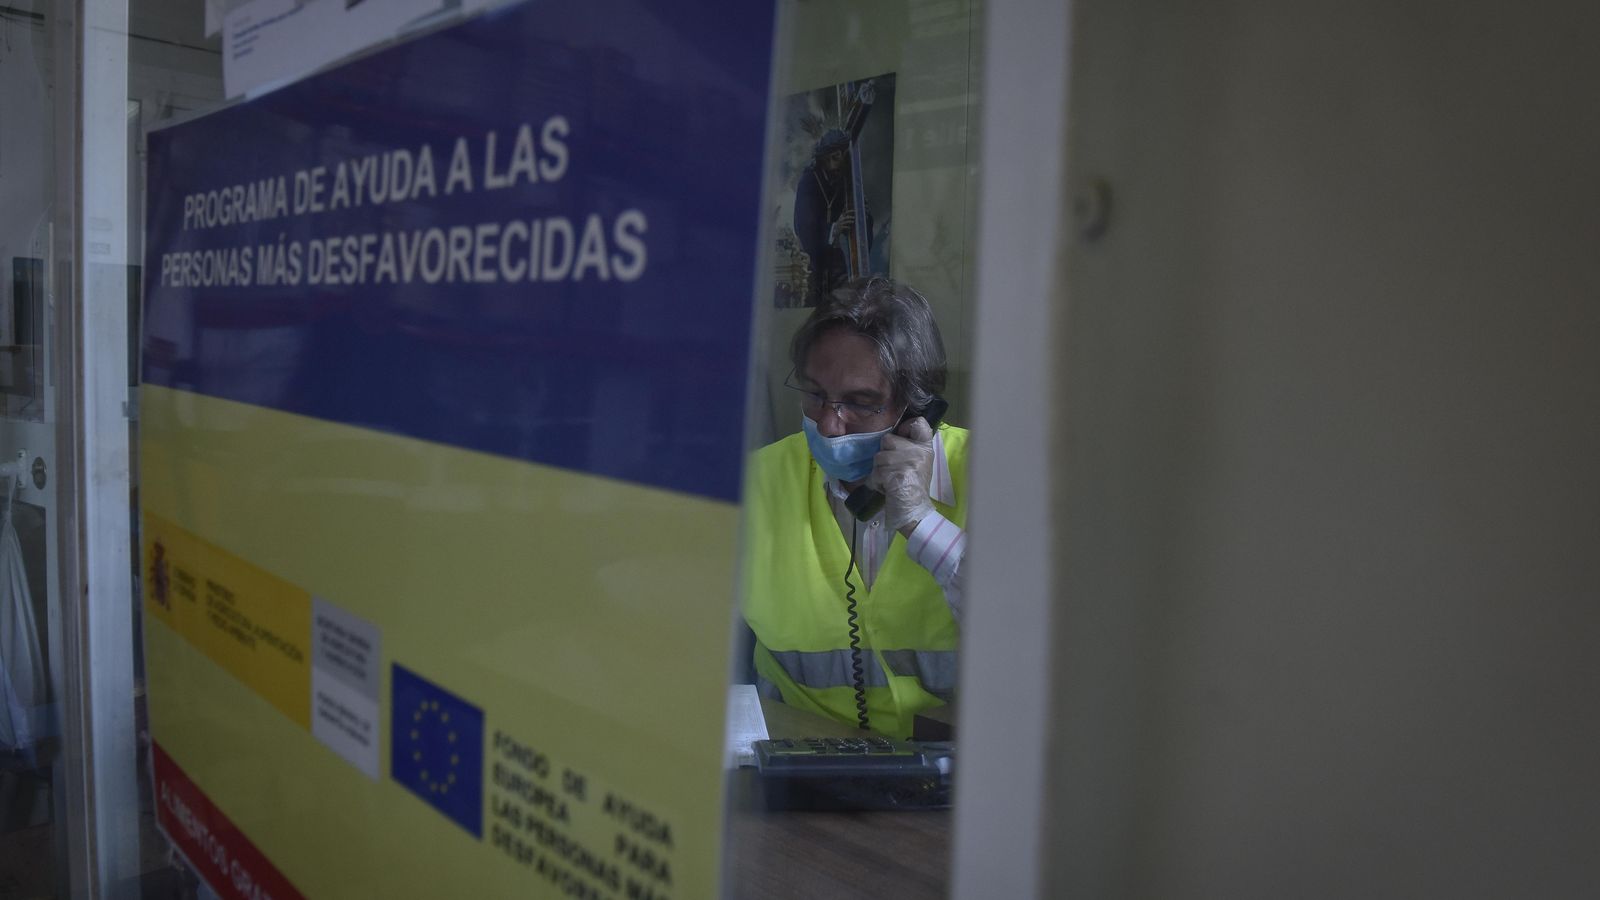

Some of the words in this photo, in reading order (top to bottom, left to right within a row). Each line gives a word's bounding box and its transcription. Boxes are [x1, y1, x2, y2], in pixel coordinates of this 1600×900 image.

[182, 177, 287, 230] PROGRAMA
[294, 165, 325, 215] DE
[330, 144, 437, 210] AYUDA
[445, 137, 473, 194] A
[484, 115, 570, 190] LAS
[161, 247, 253, 287] PERSONAS
[256, 232, 303, 286] MÁS
[308, 209, 648, 283] DESFAVORECIDAS
[492, 794, 522, 830] LAS
[493, 730, 549, 779] FONDO
[562, 768, 586, 803] DE
[604, 792, 674, 850] AYUDA
[493, 762, 571, 825] EUROPEA
[615, 834, 673, 886] PARA
